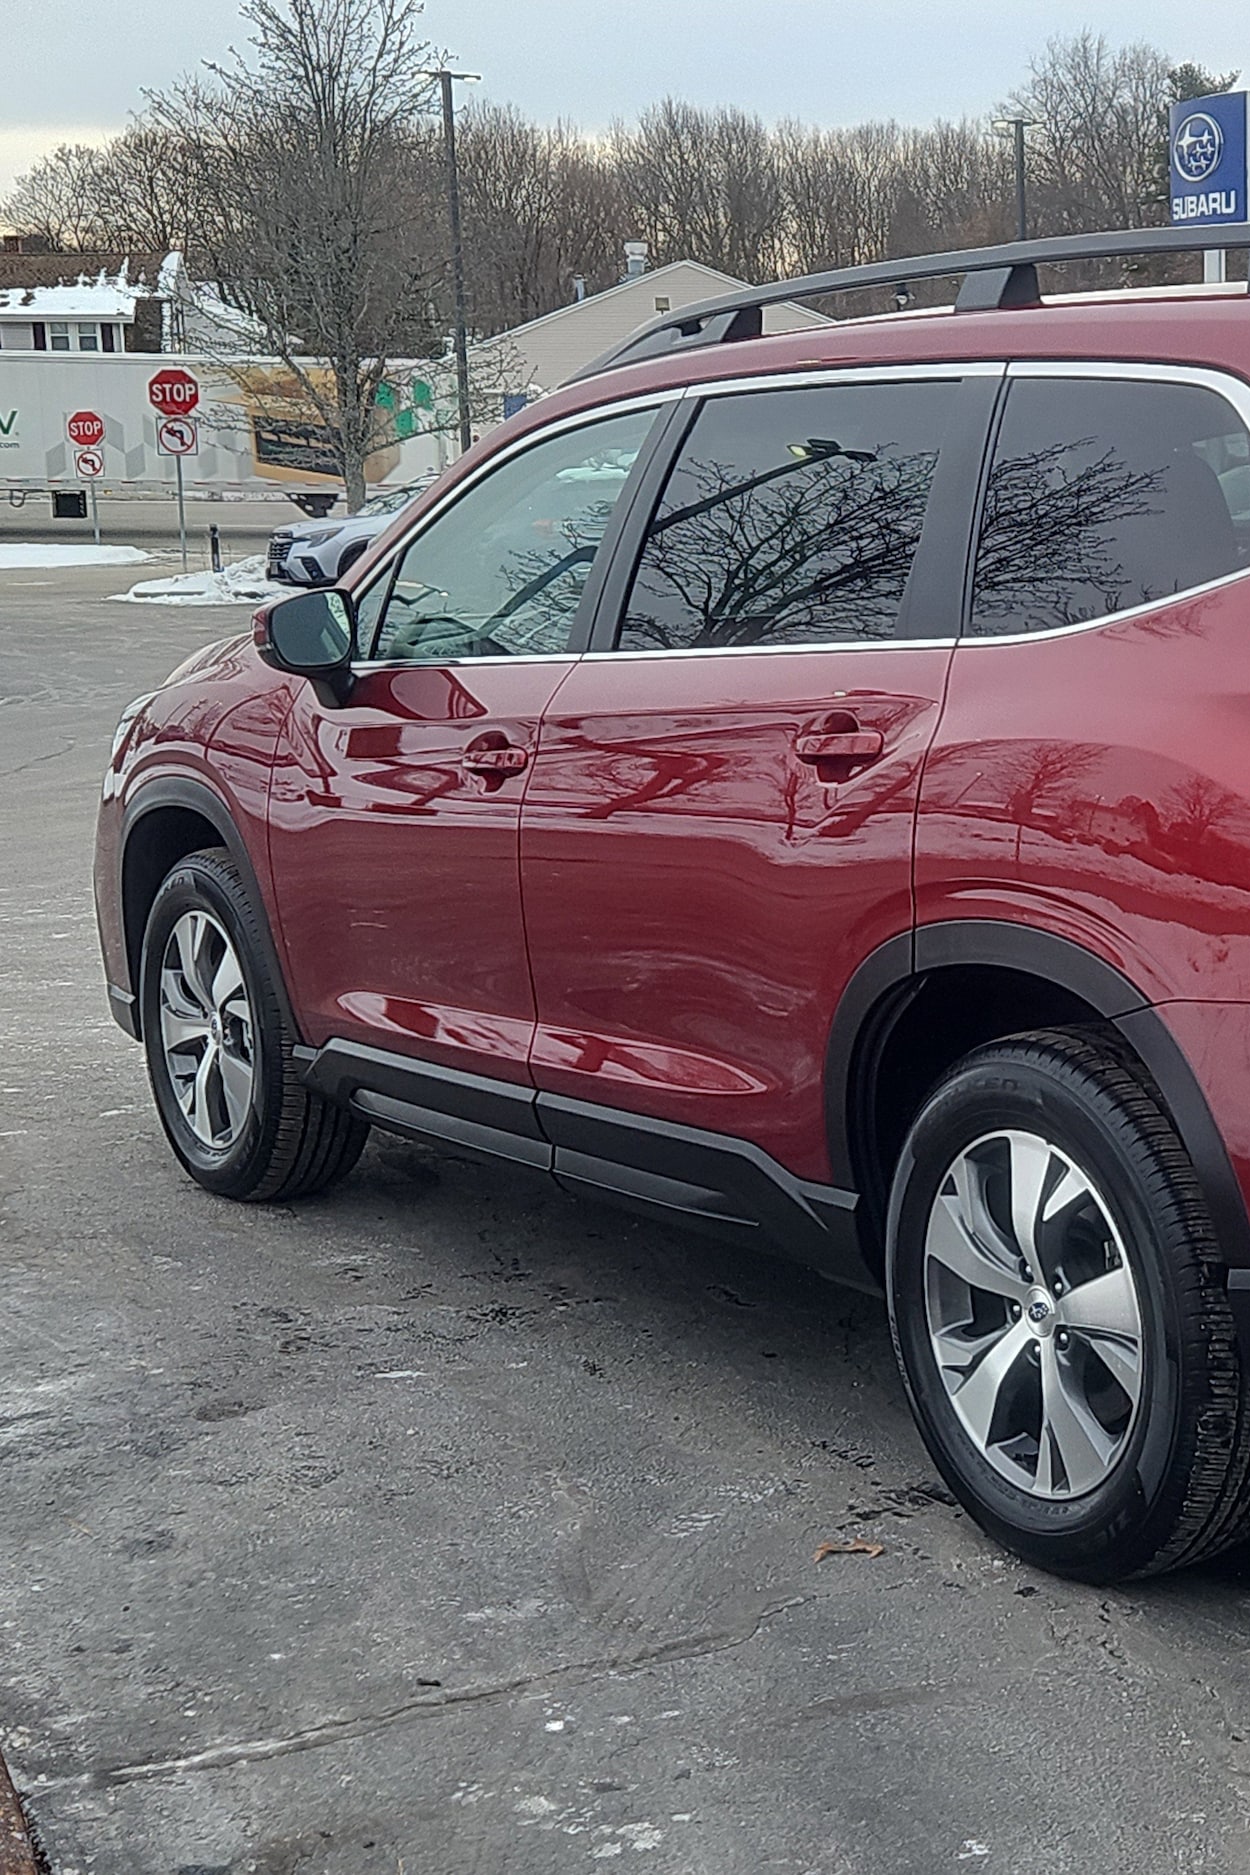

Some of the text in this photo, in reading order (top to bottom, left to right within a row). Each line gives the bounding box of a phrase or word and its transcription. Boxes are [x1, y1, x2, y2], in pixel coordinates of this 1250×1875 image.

[1172, 190, 1236, 220] SUBARU
[152, 383, 196, 403] STOP
[70, 421, 101, 436] STOP
